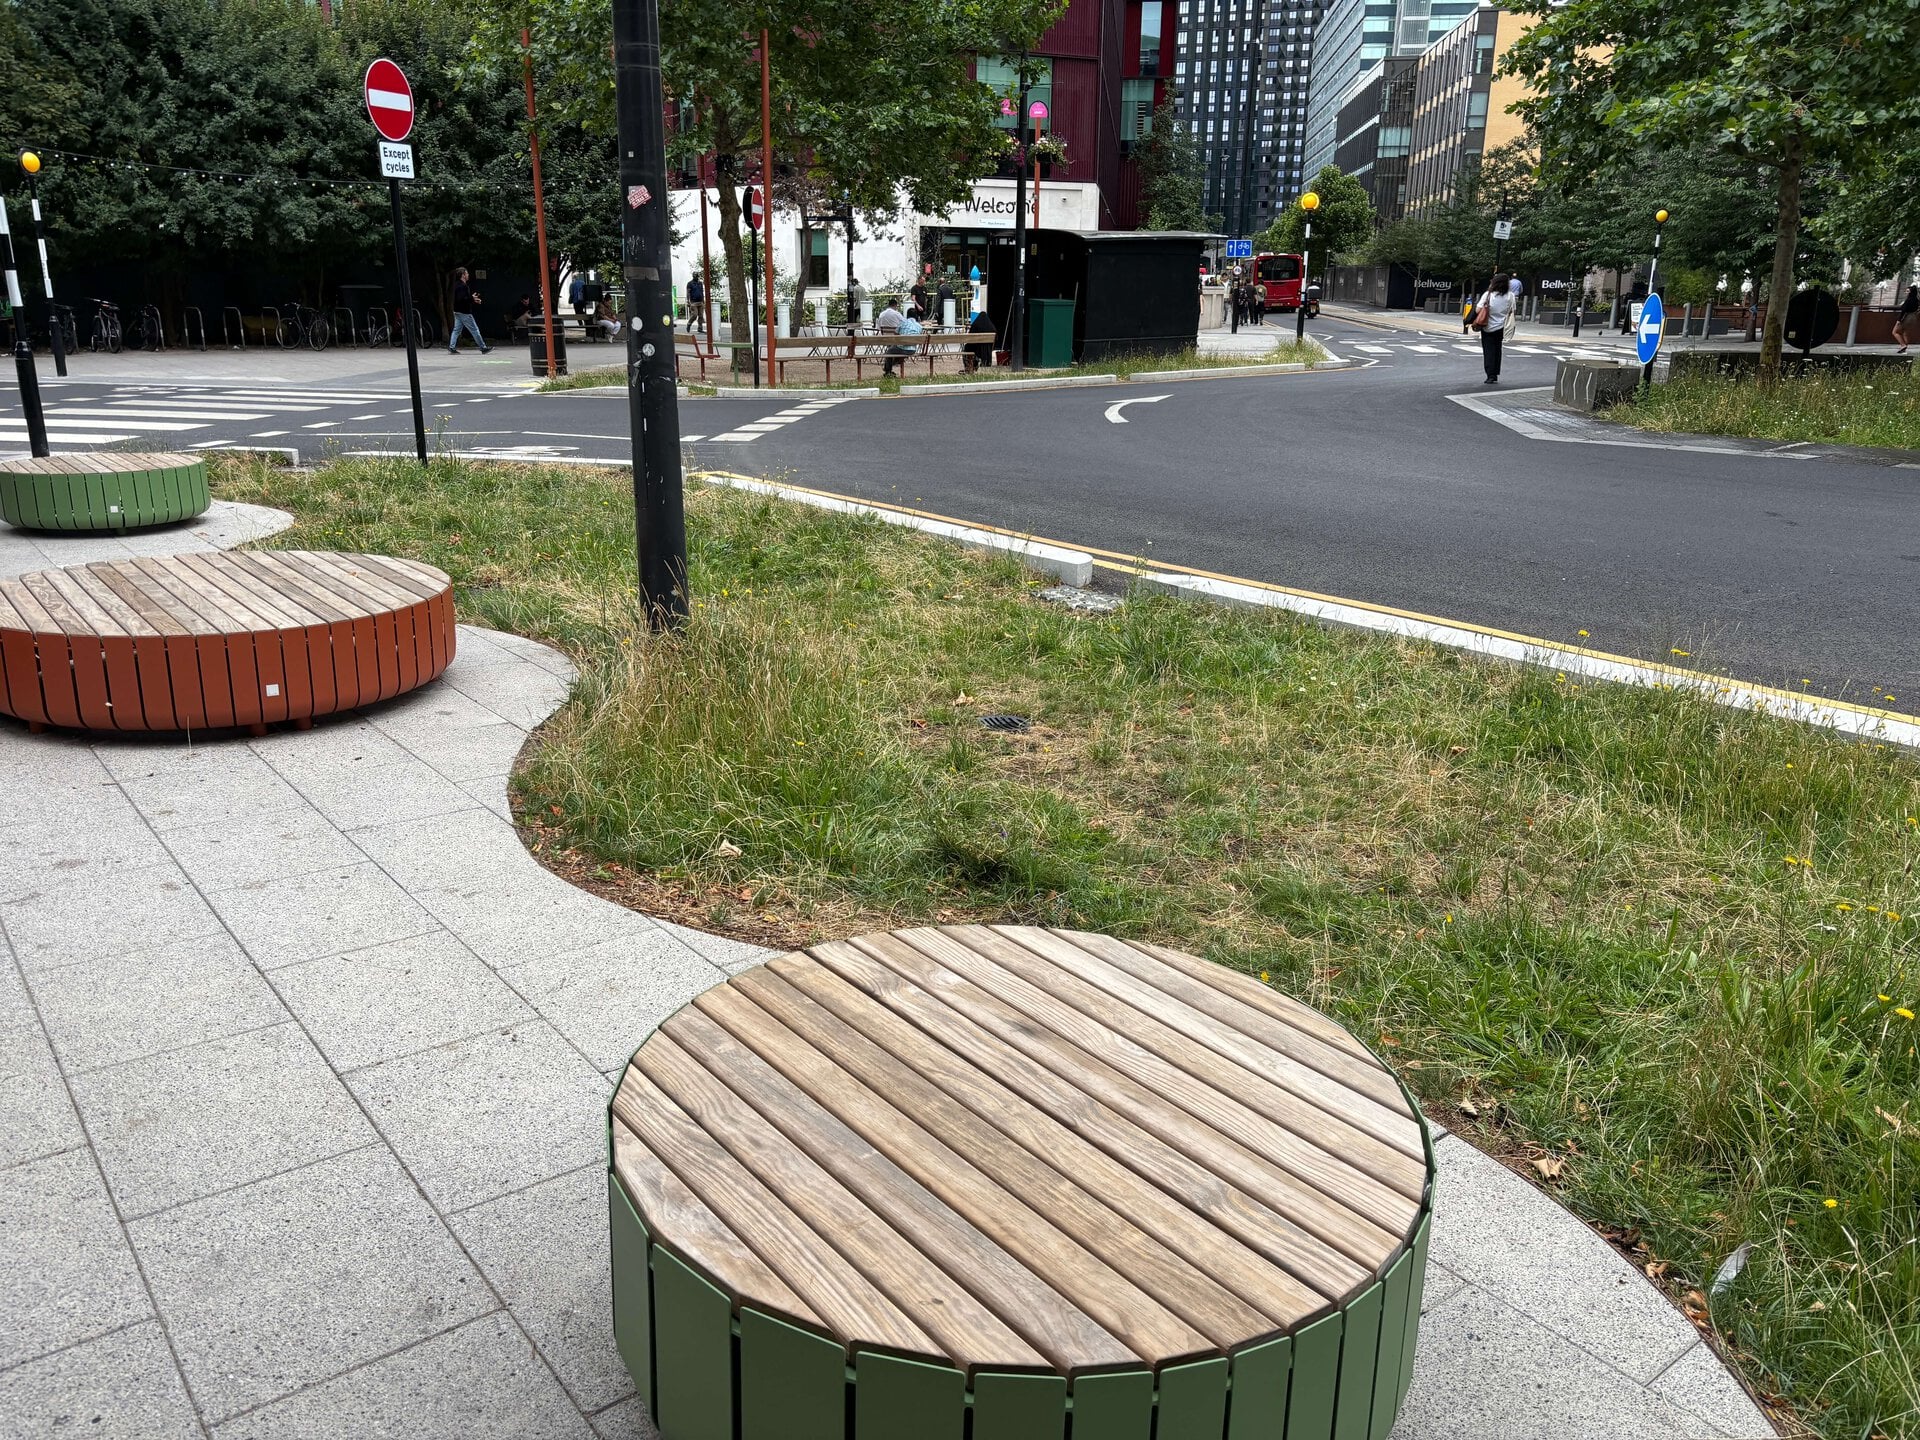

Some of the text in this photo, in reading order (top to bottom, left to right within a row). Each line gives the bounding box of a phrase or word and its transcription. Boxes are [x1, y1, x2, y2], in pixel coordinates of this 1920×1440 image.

[383, 147, 410, 160] Except
[386, 162, 410, 173] cycles
[1413, 279, 1452, 290] Bellway
